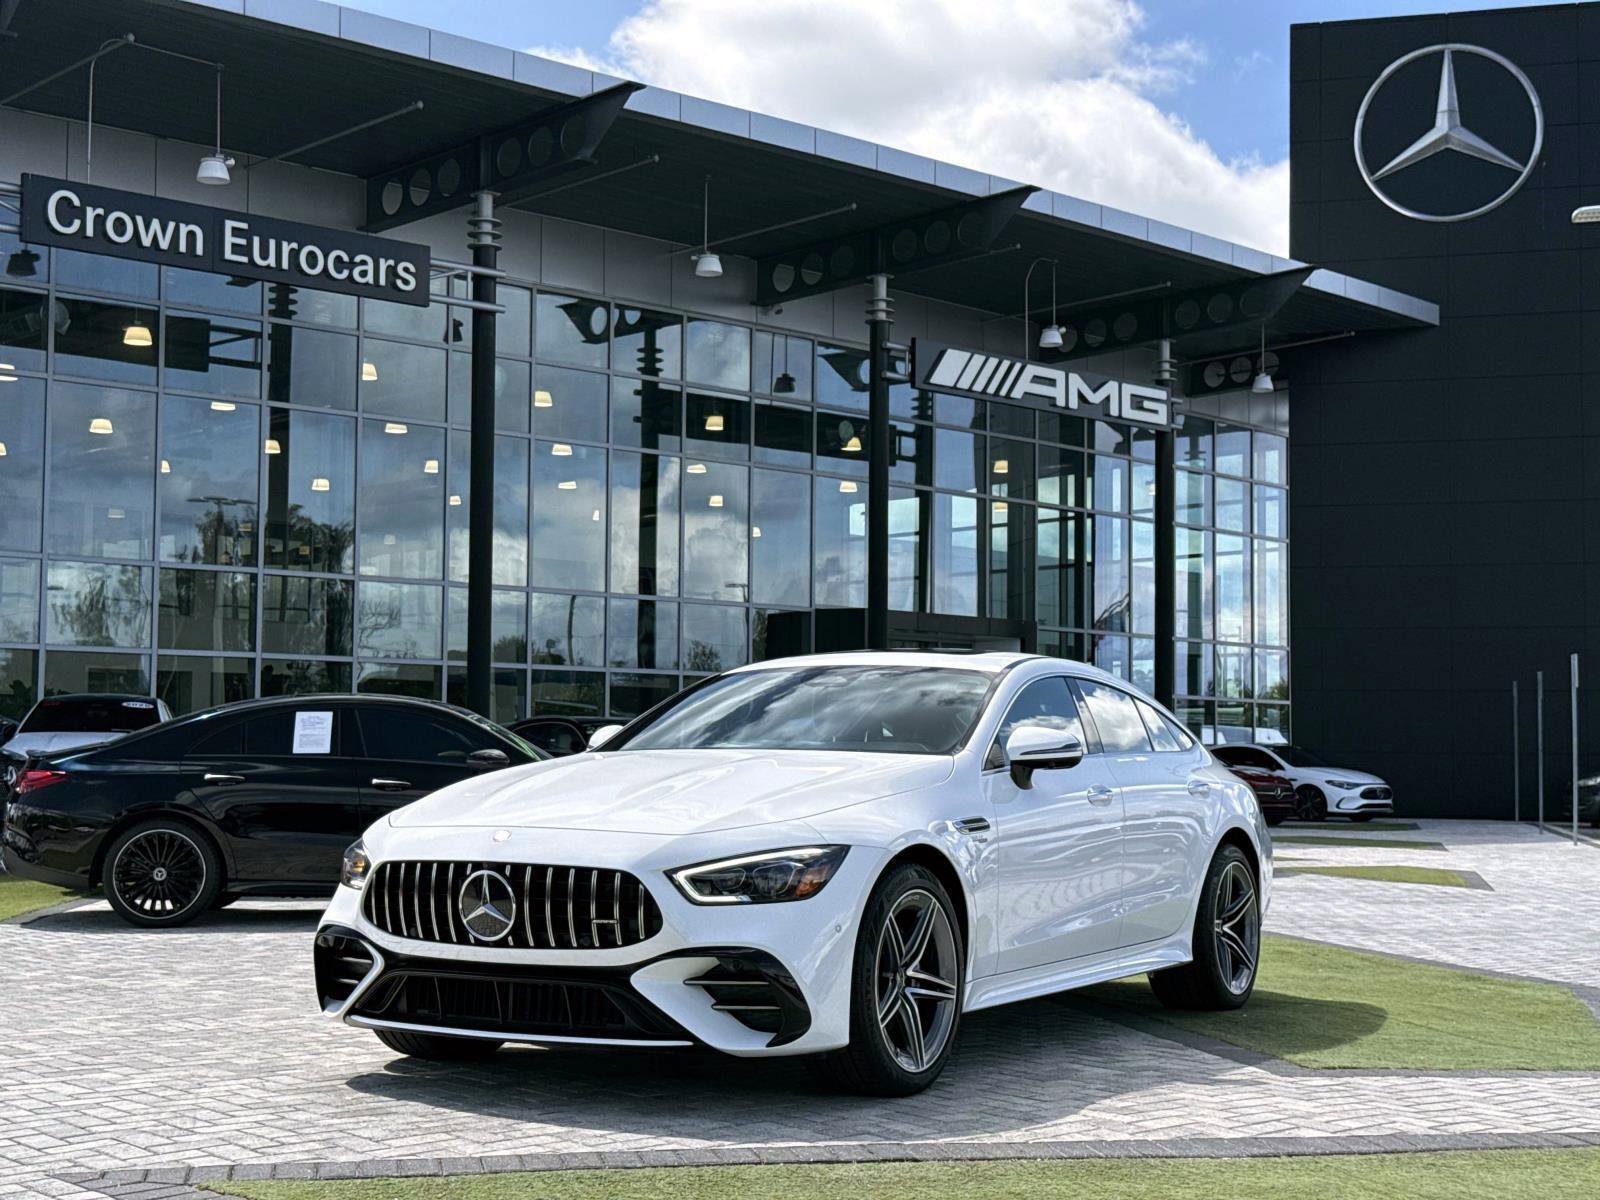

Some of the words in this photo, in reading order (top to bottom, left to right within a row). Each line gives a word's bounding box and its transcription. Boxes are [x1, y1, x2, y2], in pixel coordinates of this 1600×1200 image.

[47, 189, 204, 256] Crown
[224, 219, 416, 292] Eurocars
[1010, 364, 1168, 426] AMG
